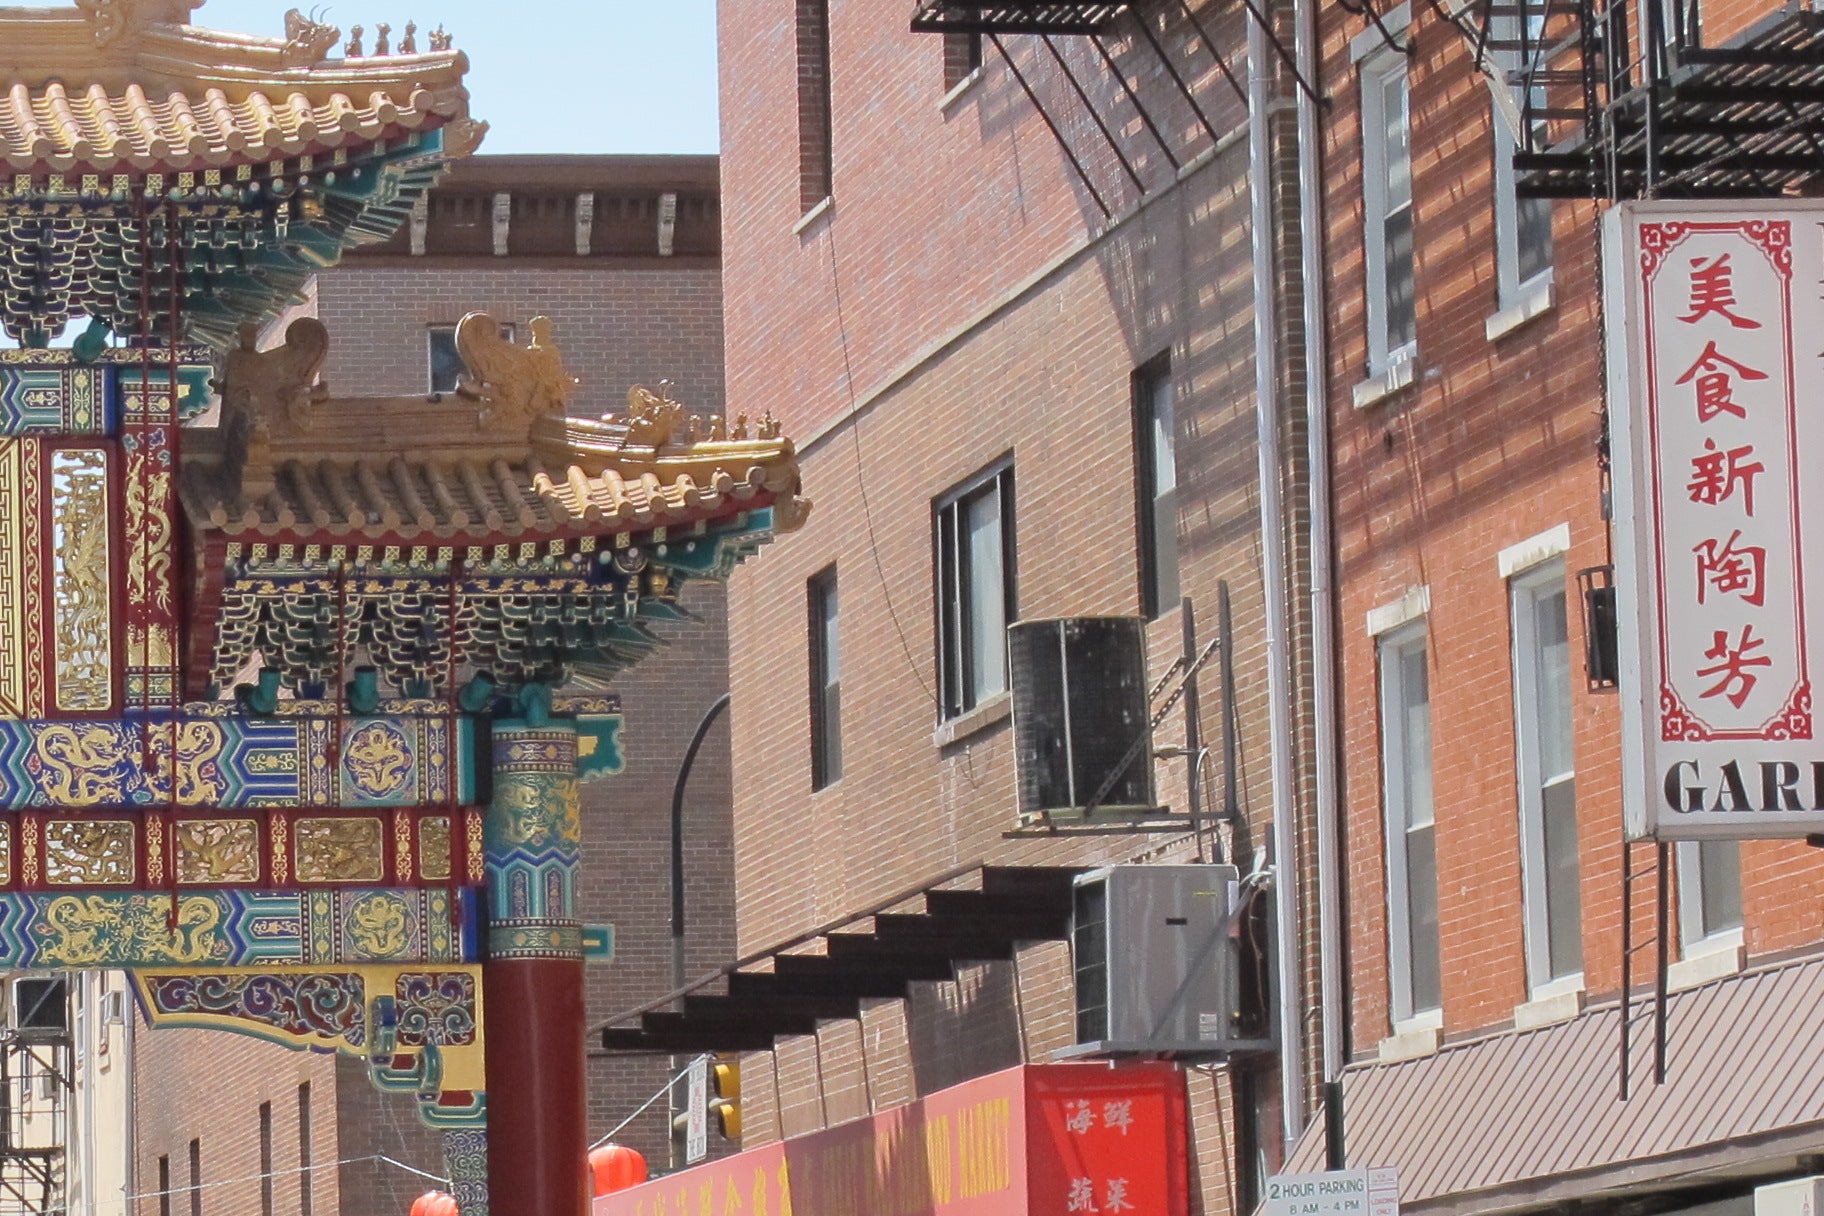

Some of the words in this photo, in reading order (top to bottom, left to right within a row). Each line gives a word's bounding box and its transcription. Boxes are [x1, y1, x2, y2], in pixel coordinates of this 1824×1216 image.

[1270, 1184, 1281, 1200] 2
[1282, 1183, 1316, 1198] HOUR
[1319, 1178, 1365, 1195] PARKING
[1289, 1204, 1297, 1215] 8
[1302, 1203, 1319, 1214] AM
[1333, 1202, 1340, 1211] 4
[1344, 1200, 1360, 1210] PM
